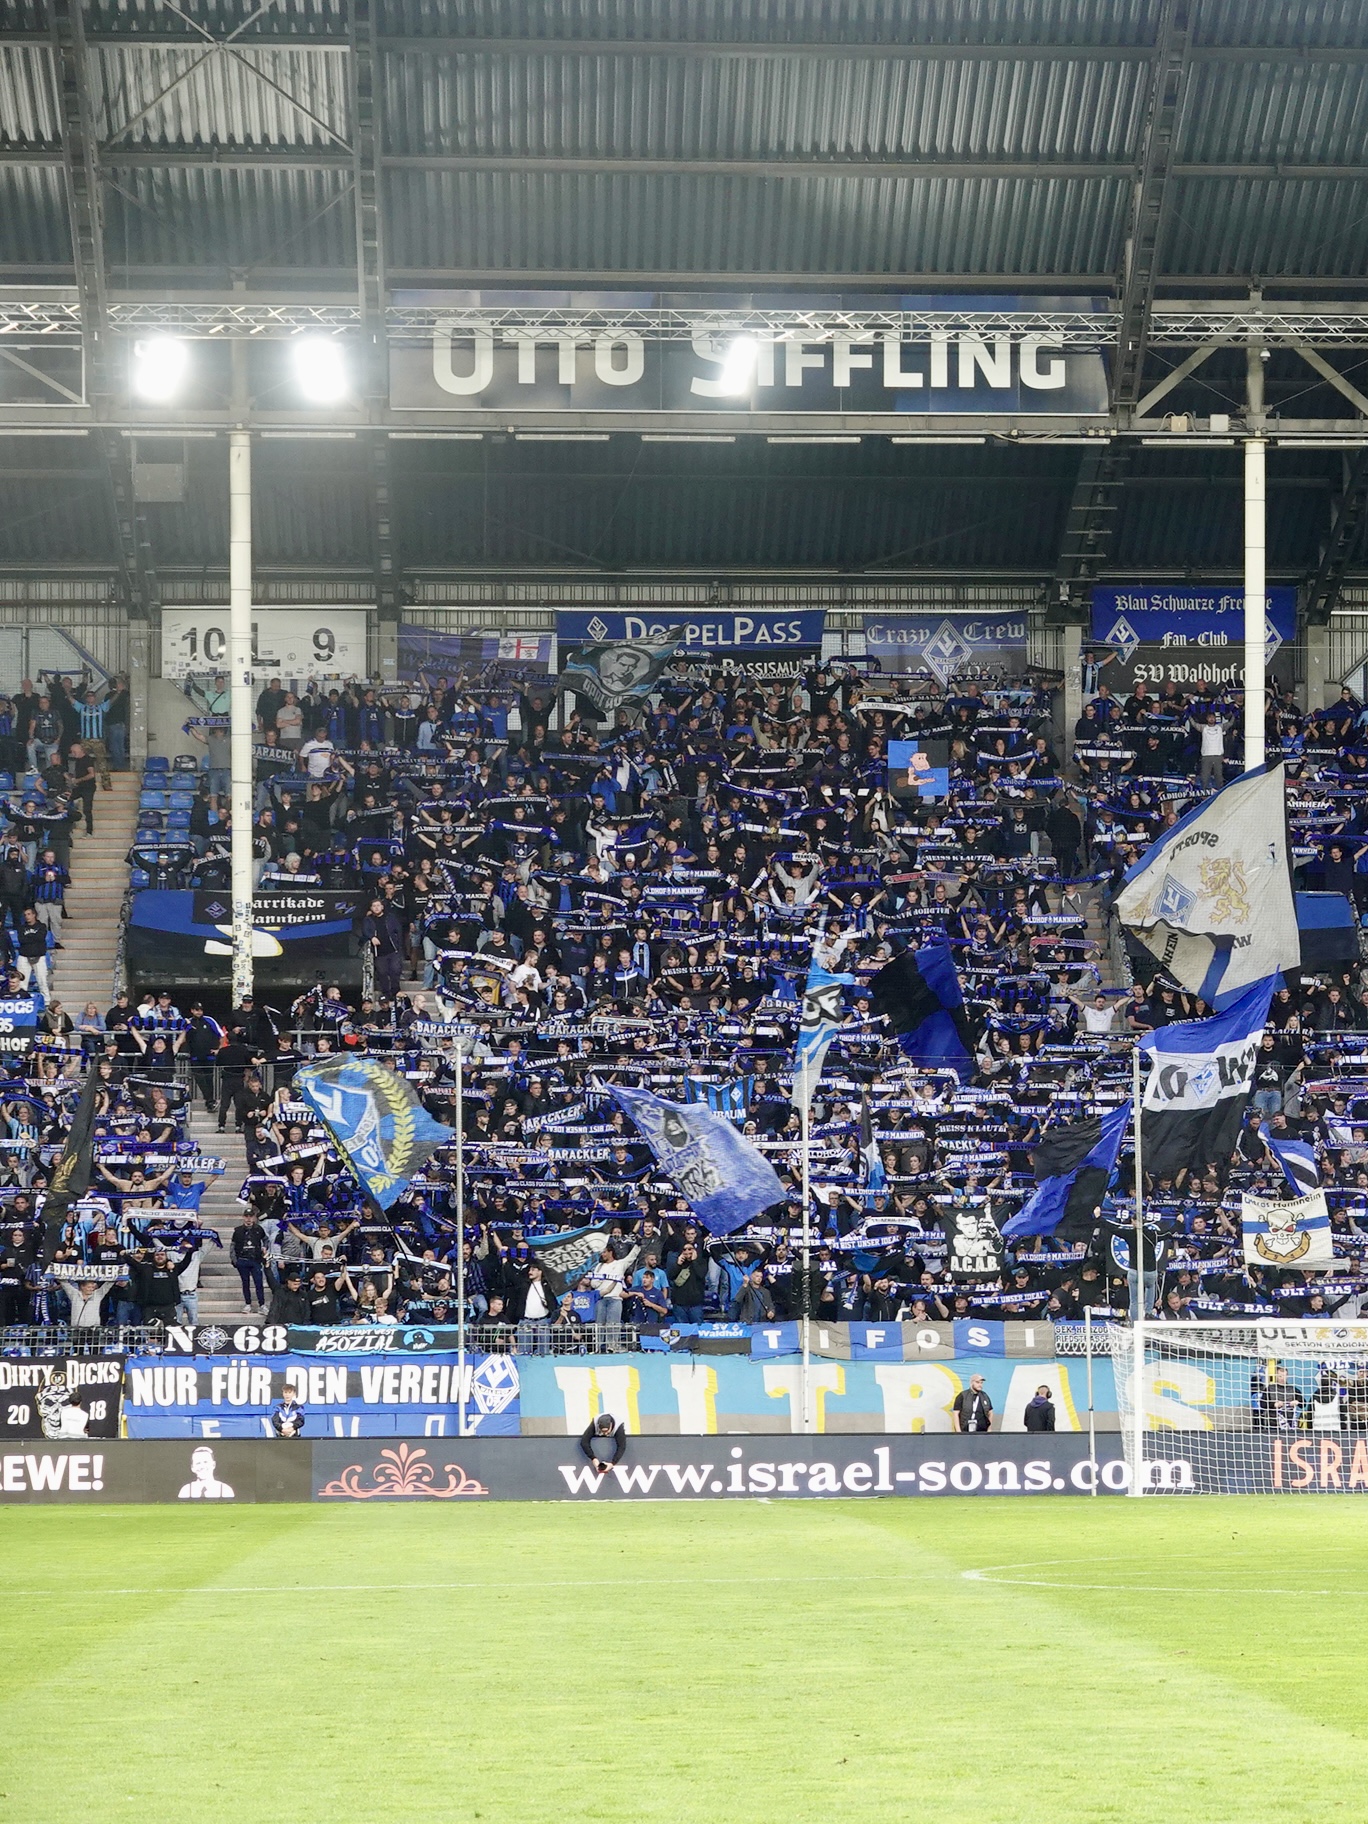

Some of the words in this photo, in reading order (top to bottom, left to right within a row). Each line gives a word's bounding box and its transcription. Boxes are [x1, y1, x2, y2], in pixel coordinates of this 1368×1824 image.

[433, 319, 645, 396] OTTO
[1114, 595, 1147, 611] Blau
[1150, 594, 1214, 612] Schwarze
[867, 625, 930, 646] Crazy
[963, 621, 1025, 641] Crew
[1160, 631, 1187, 649] Fan
[1197, 631, 1228, 646] Club
[313, 628, 335, 662] 9
[416, 1020, 481, 1036] BARACKLER
[549, 1149, 610, 1161] BARACKLER
[54, 1264, 119, 1278] BARACKLER
[951, 1256, 1000, 1273] A.C.A.B.
[999, 1294, 1022, 1304] UNSER
[1023, 1292, 1044, 1302] IDEAL
[1280, 1287, 1305, 1296] ULT
[1324, 1285, 1352, 1295] RAS
[1198, 1301, 1223, 1311] ULT
[1244, 1303, 1273, 1314] RAS
[698, 1328, 744, 1338] Waldhof
[712, 1323, 727, 1331] SV
[165, 1326, 196, 1352] N
[234, 1325, 288, 1352] 68
[315, 1335, 399, 1352] ASOZIAL
[0, 1361, 51, 1391] DIRTY
[66, 1359, 121, 1389] DICKS
[132, 1366, 198, 1407] NUR
[211, 1359, 272, 1406] FÜR
[285, 1365, 348, 1405] DEN
[360, 1364, 474, 1404] VEREIN
[7, 1404, 30, 1425] 20
[89, 1400, 107, 1421] 18
[0, 1455, 104, 1491] EWE!
[558, 1446, 1195, 1494] www.israel-sons.com
